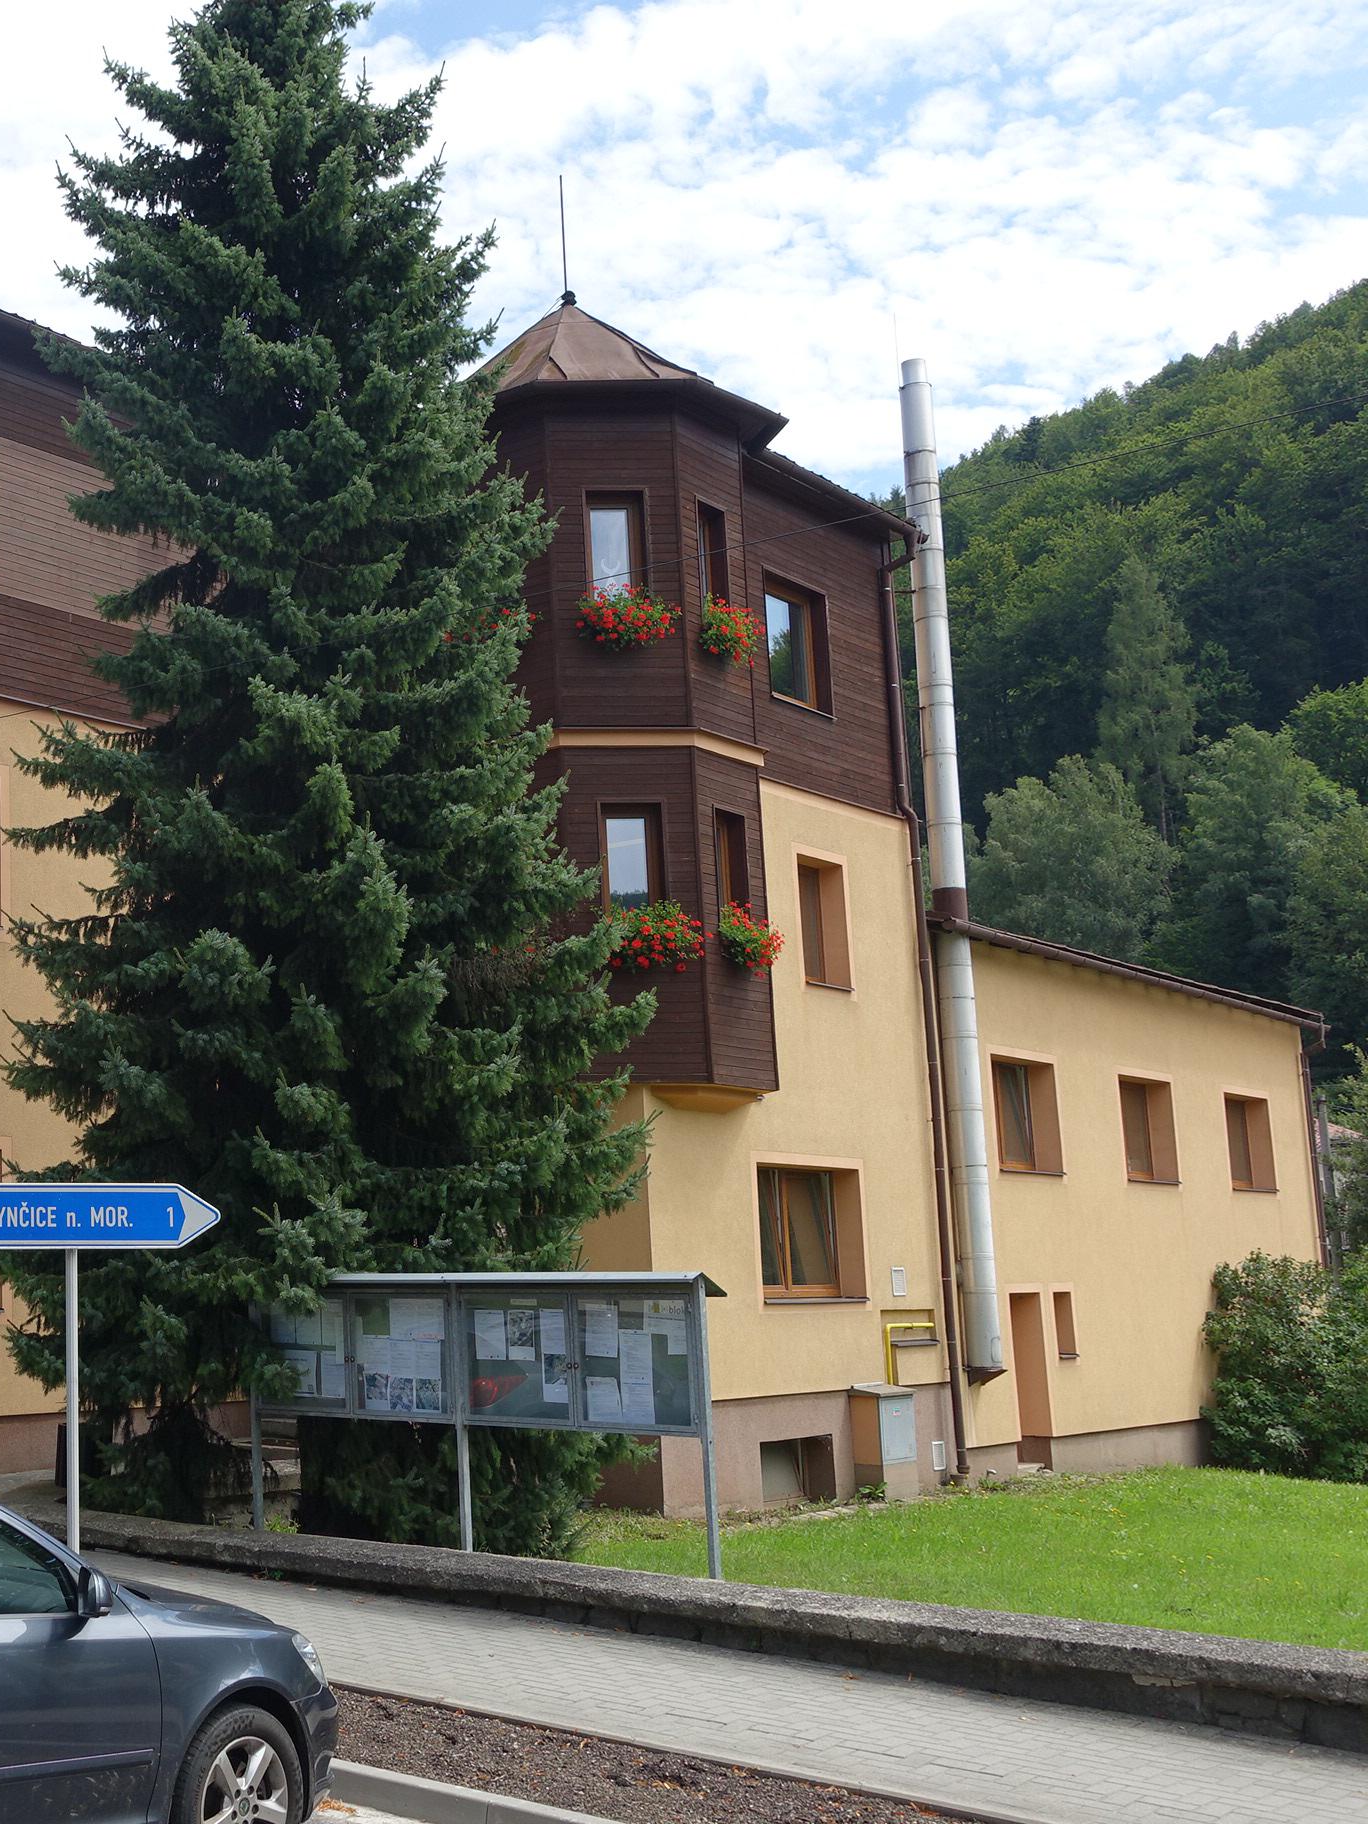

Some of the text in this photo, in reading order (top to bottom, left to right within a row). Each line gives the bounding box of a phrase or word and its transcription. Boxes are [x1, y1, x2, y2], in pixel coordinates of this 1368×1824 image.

[66, 1211, 81, 1228] n.
[90, 1207, 133, 1228] MOR.
[166, 1207, 175, 1228] 1
